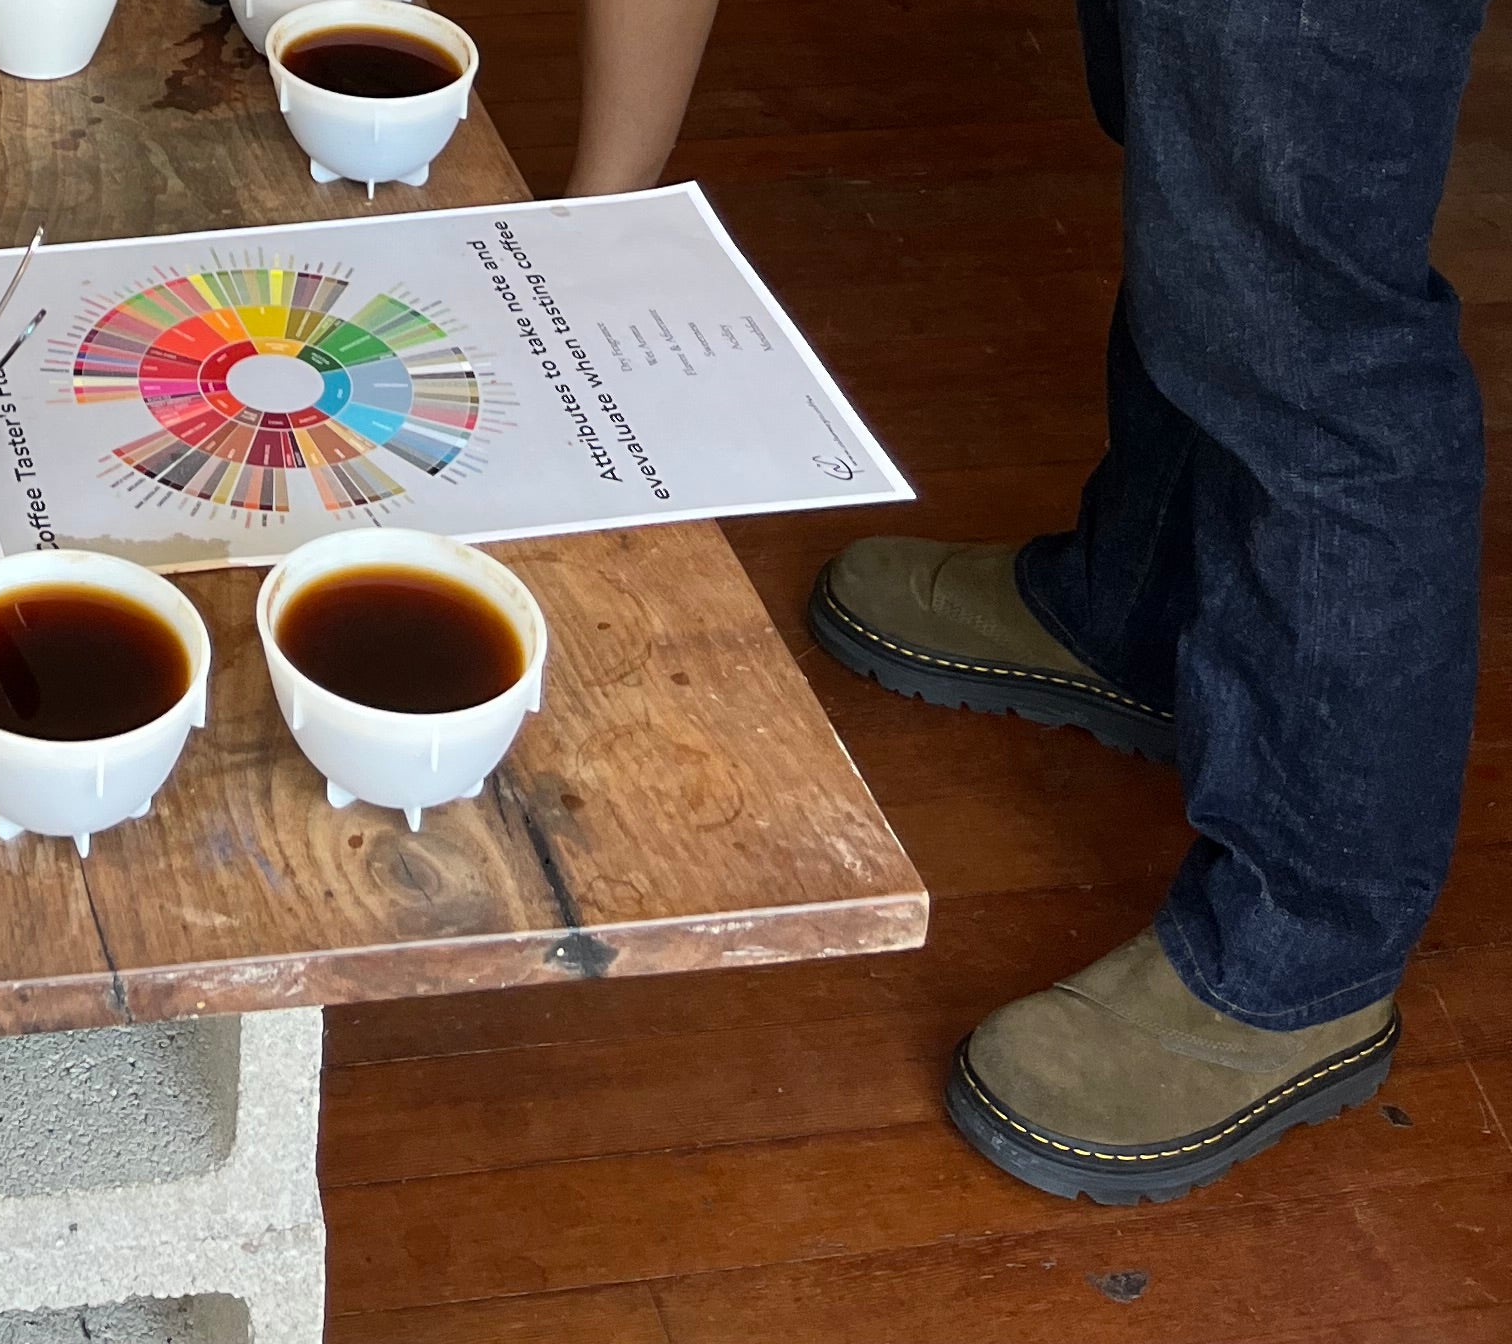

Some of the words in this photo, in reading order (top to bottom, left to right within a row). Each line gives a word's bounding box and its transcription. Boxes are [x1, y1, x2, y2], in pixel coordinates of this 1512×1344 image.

[466, 240, 499, 271] and
[494, 220, 532, 270] coffee
[492, 275, 523, 312] note
[526, 274, 571, 335] tasting
[517, 317, 548, 356] take
[541, 360, 560, 380] to
[565, 338, 603, 388] when
[554, 383, 623, 483] Attributes
[598, 392, 671, 500] evevaluate
